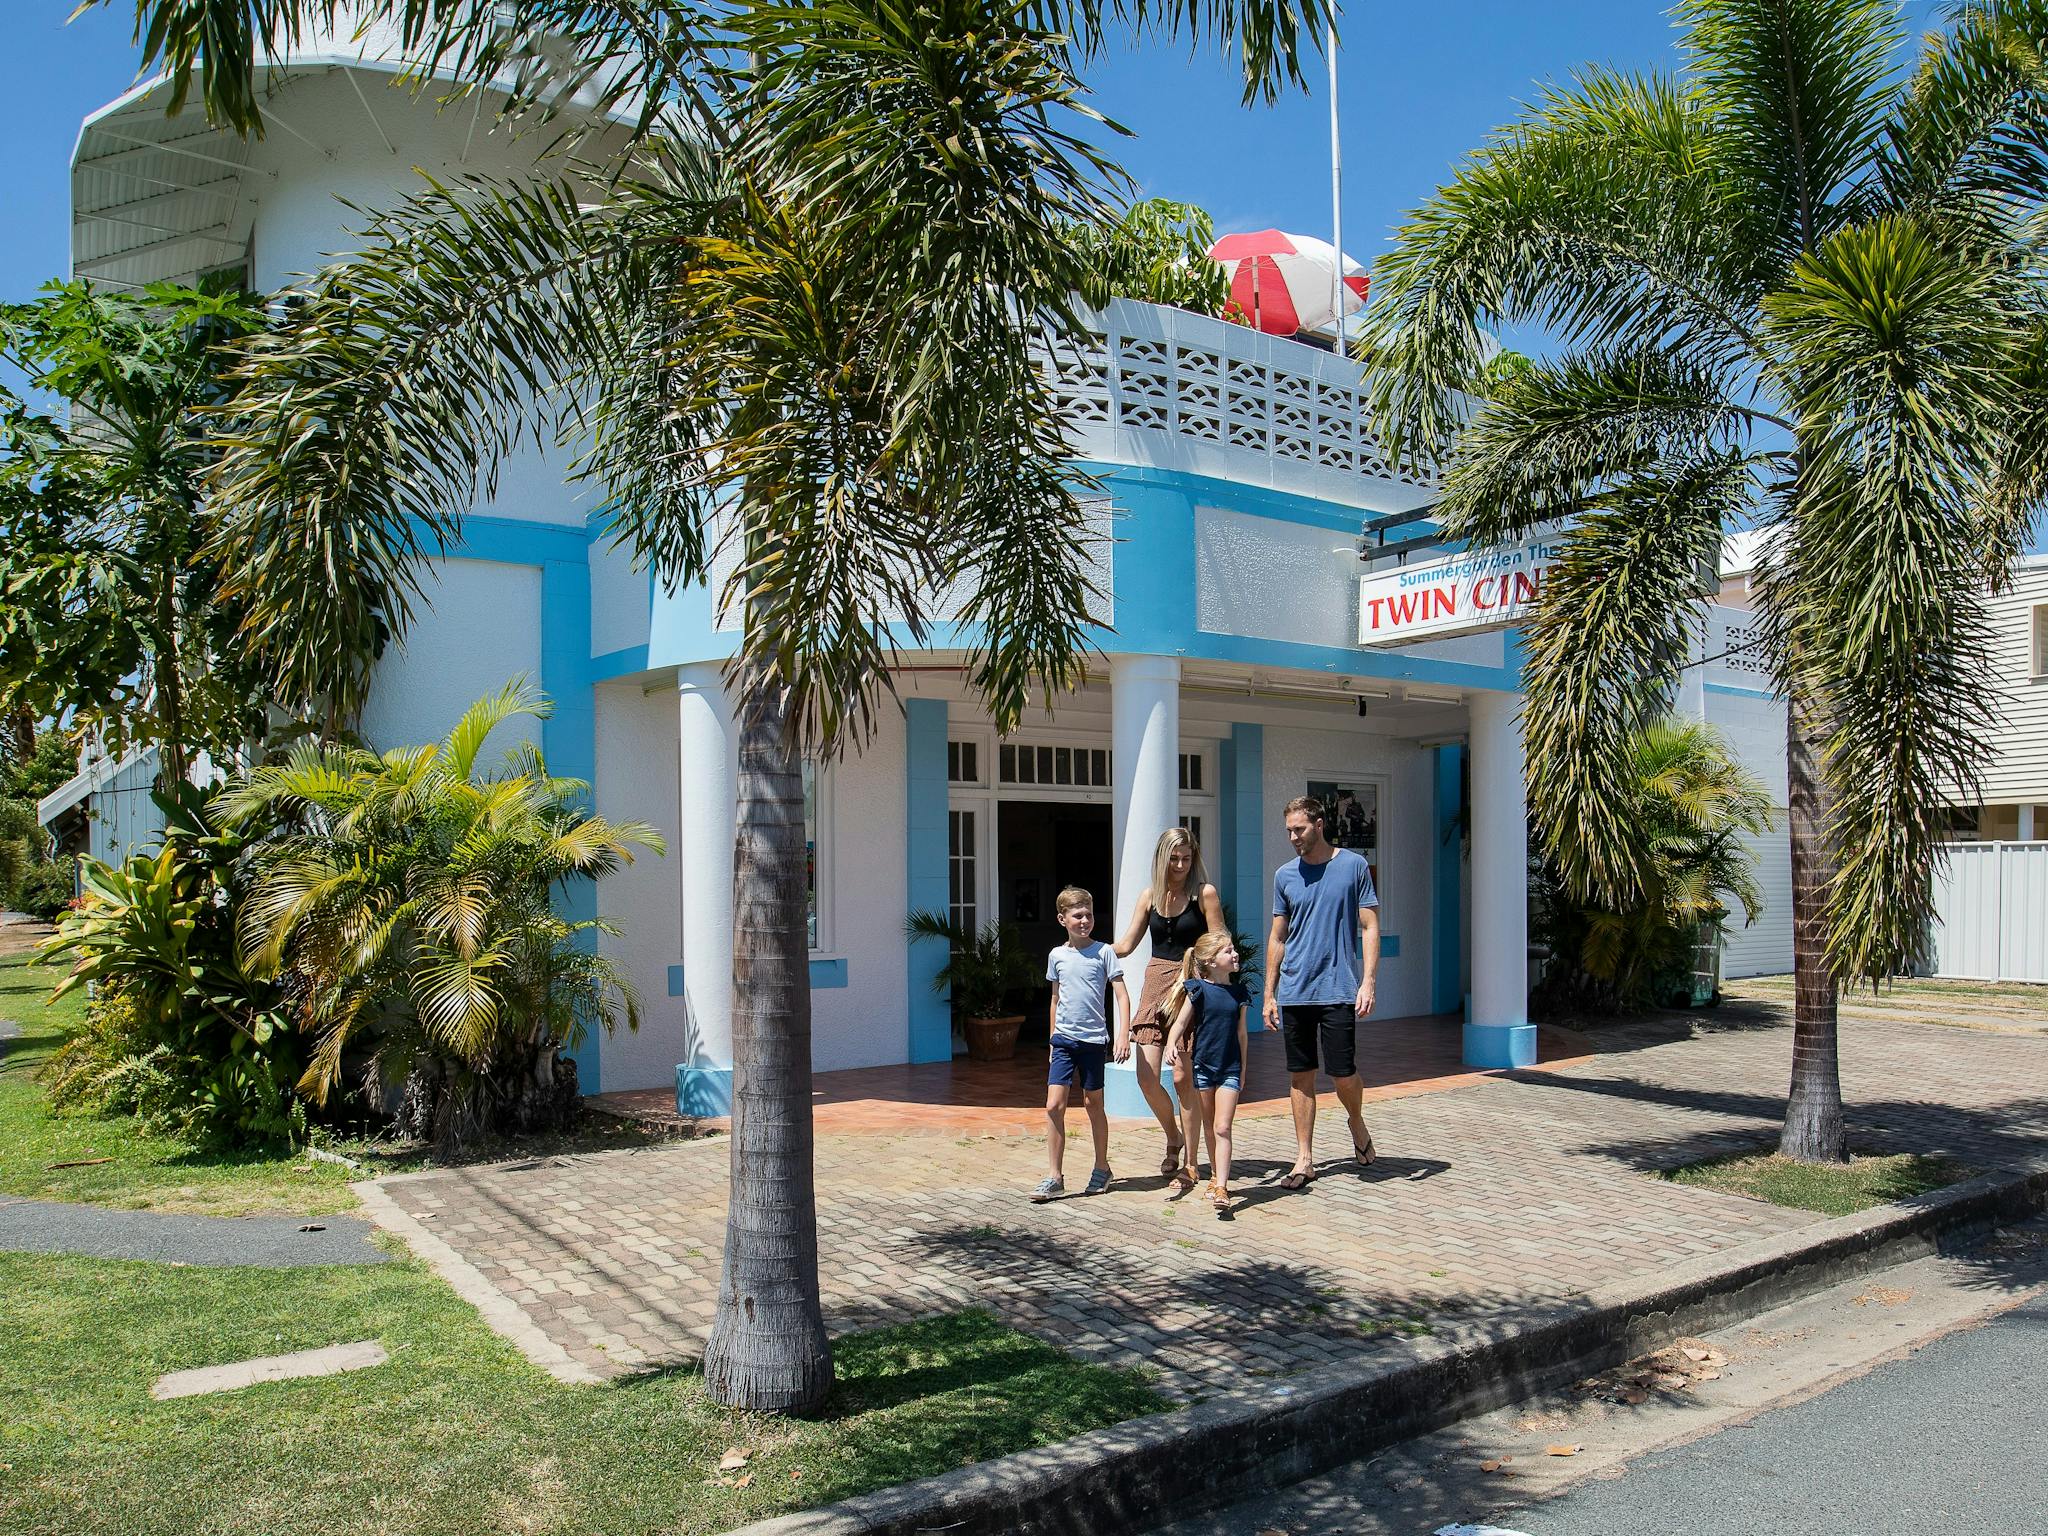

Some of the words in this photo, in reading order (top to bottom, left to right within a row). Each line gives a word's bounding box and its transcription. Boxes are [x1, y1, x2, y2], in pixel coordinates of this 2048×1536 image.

[1399, 551, 1522, 588] Summergarden
[1367, 584, 1457, 629] TWIN
[1472, 566, 1554, 610] CIN
